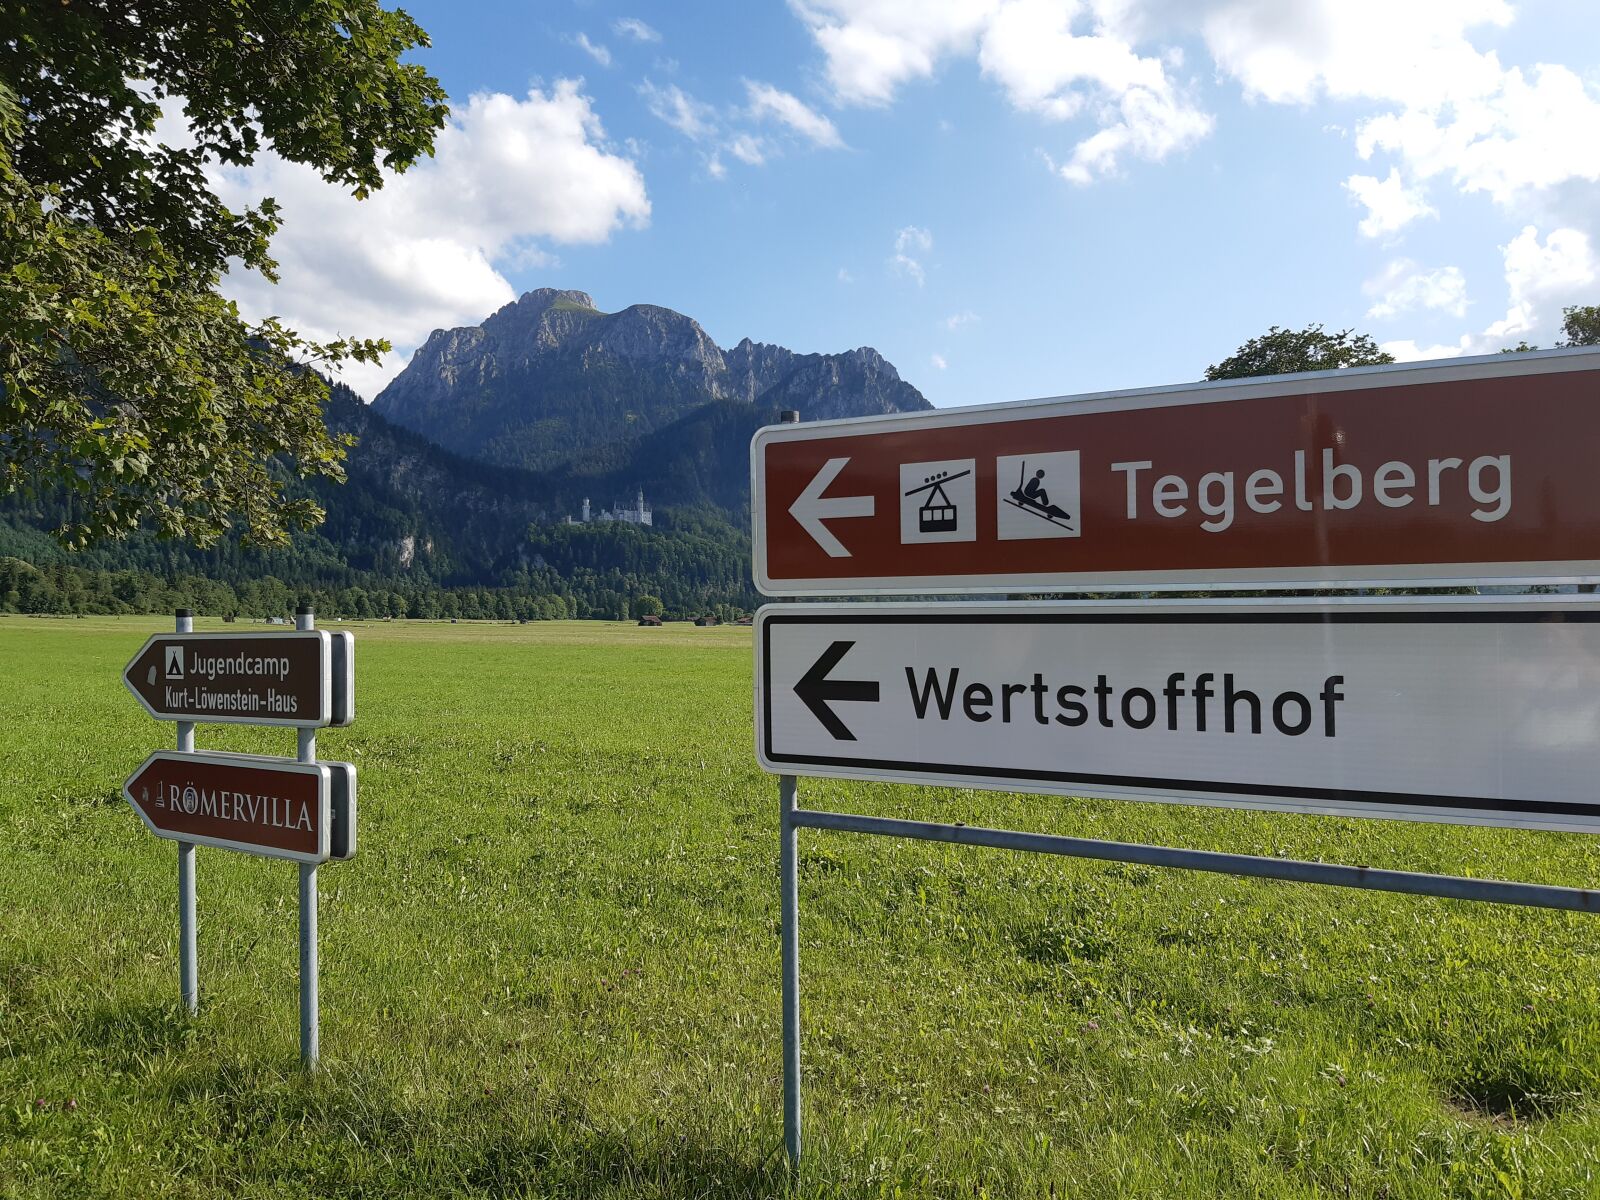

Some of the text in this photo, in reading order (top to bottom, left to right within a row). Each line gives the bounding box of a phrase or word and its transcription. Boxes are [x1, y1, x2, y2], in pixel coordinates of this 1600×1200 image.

[1111, 447, 1512, 534] Tegelberg
[190, 652, 289, 680] Jugendcamp
[165, 686, 298, 713] Kurt-Löwenstein-Haus
[905, 666, 1345, 738] Wertstoffhof
[169, 781, 313, 831] RÖMERVILLA
